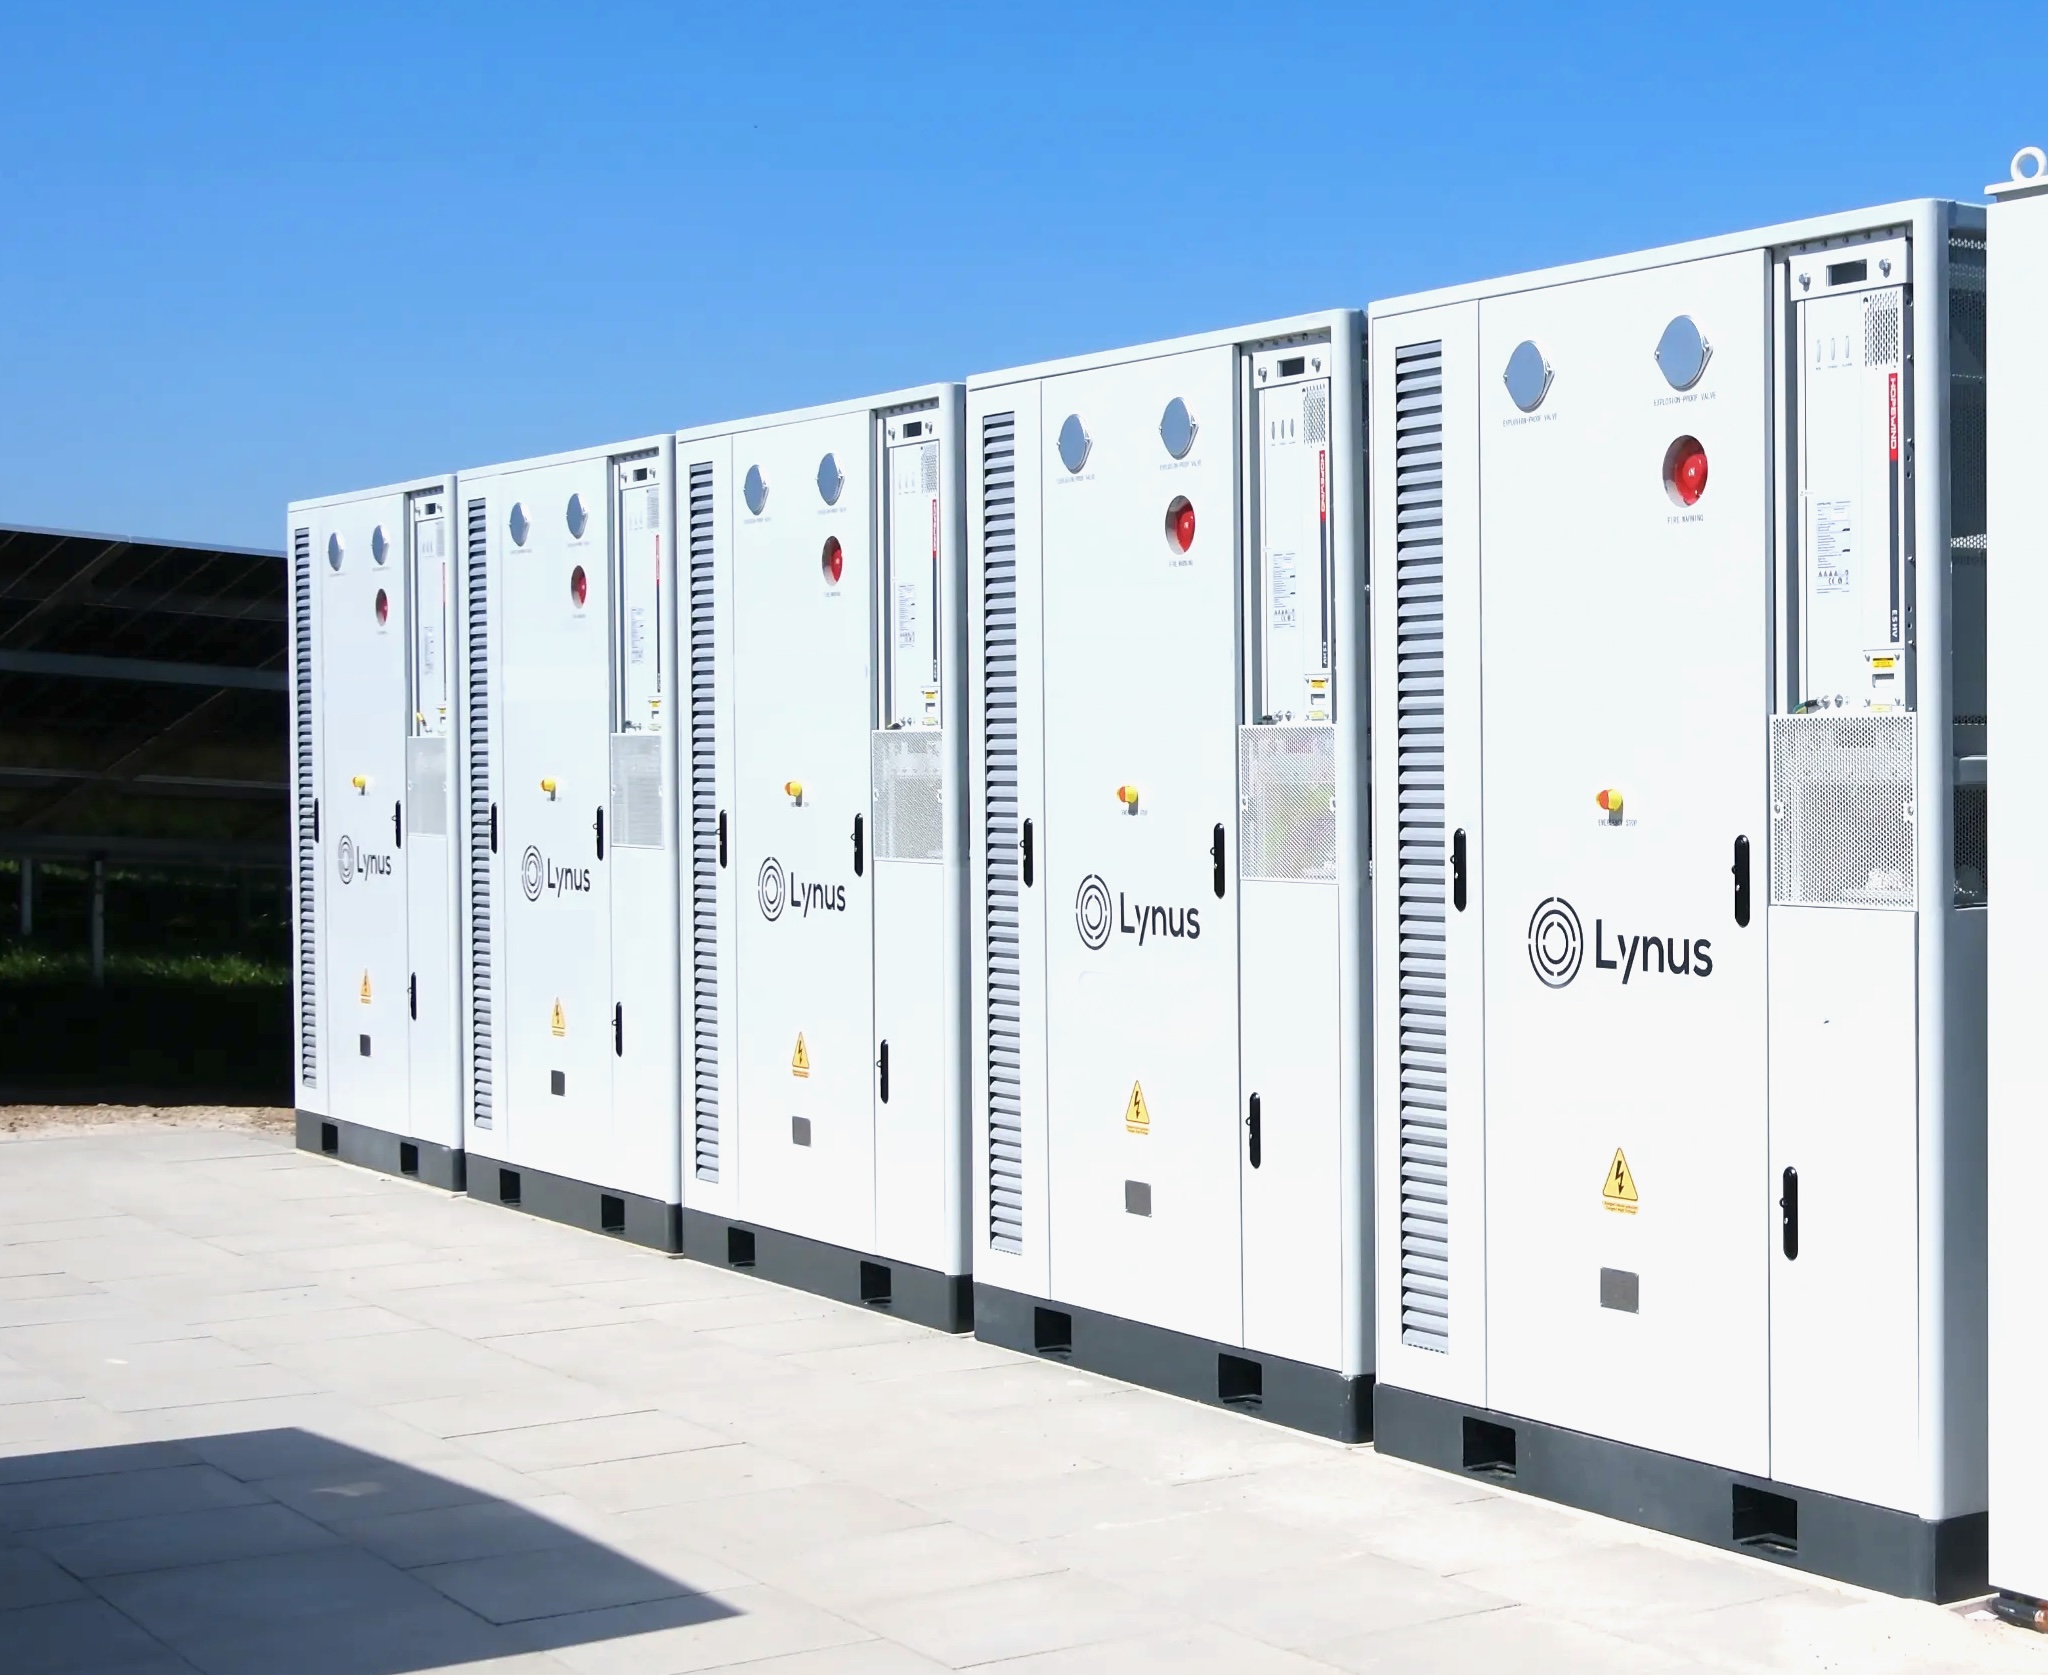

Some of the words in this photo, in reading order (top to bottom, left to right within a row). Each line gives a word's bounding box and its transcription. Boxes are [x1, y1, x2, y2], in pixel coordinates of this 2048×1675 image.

[1890, 377, 1898, 450] HOPEWIND
[356, 845, 392, 881] Lynus
[547, 858, 591, 898] Lynus
[791, 872, 846, 918] Lynus
[1120, 891, 1201, 946] Lynus
[1595, 919, 1713, 985] Lynus
